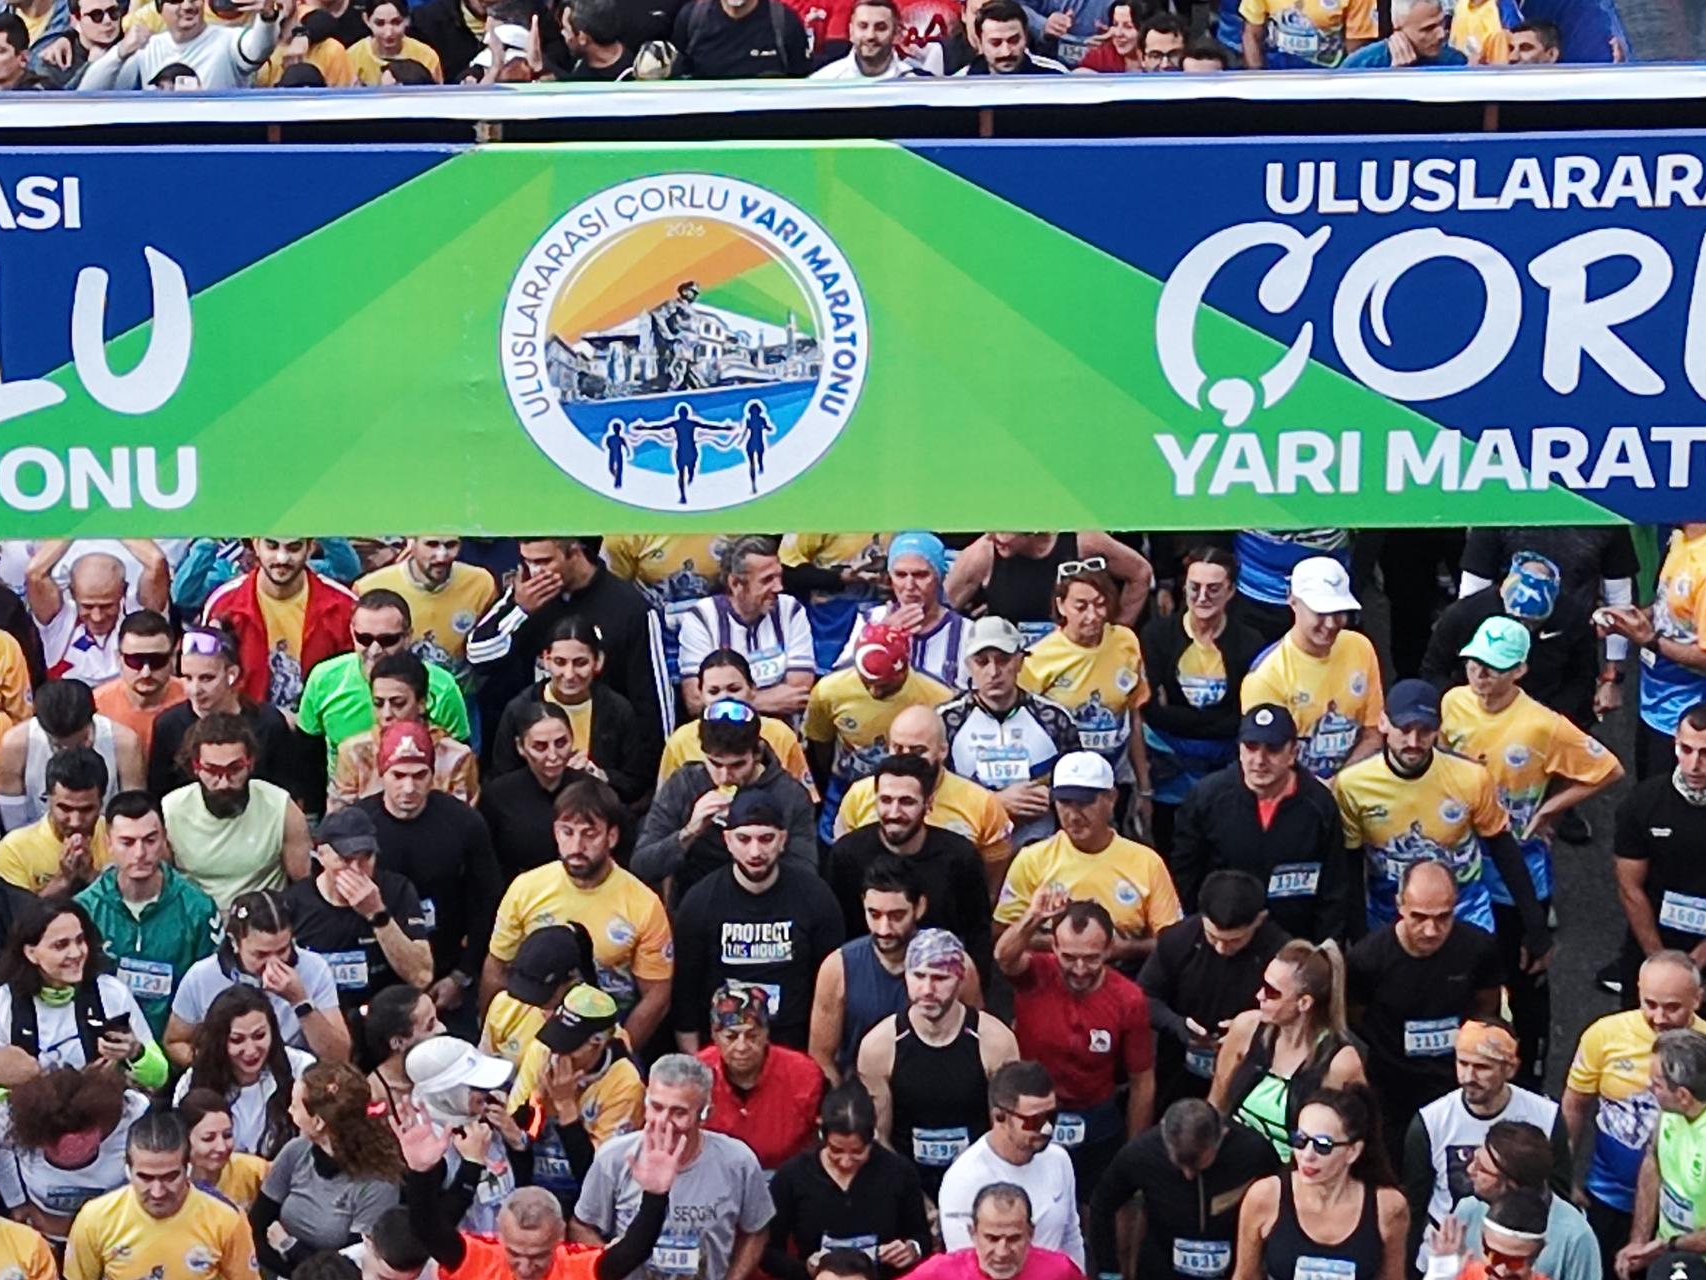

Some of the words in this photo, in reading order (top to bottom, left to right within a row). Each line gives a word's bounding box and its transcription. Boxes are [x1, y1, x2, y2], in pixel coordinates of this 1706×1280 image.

[512, 206, 610, 419] ULUSLARARASI
[614, 184, 730, 222] ÇORLU
[739, 193, 808, 249] YARI
[801, 243, 858, 418] MARATONU
[1153, 429, 1359, 496] YARI
